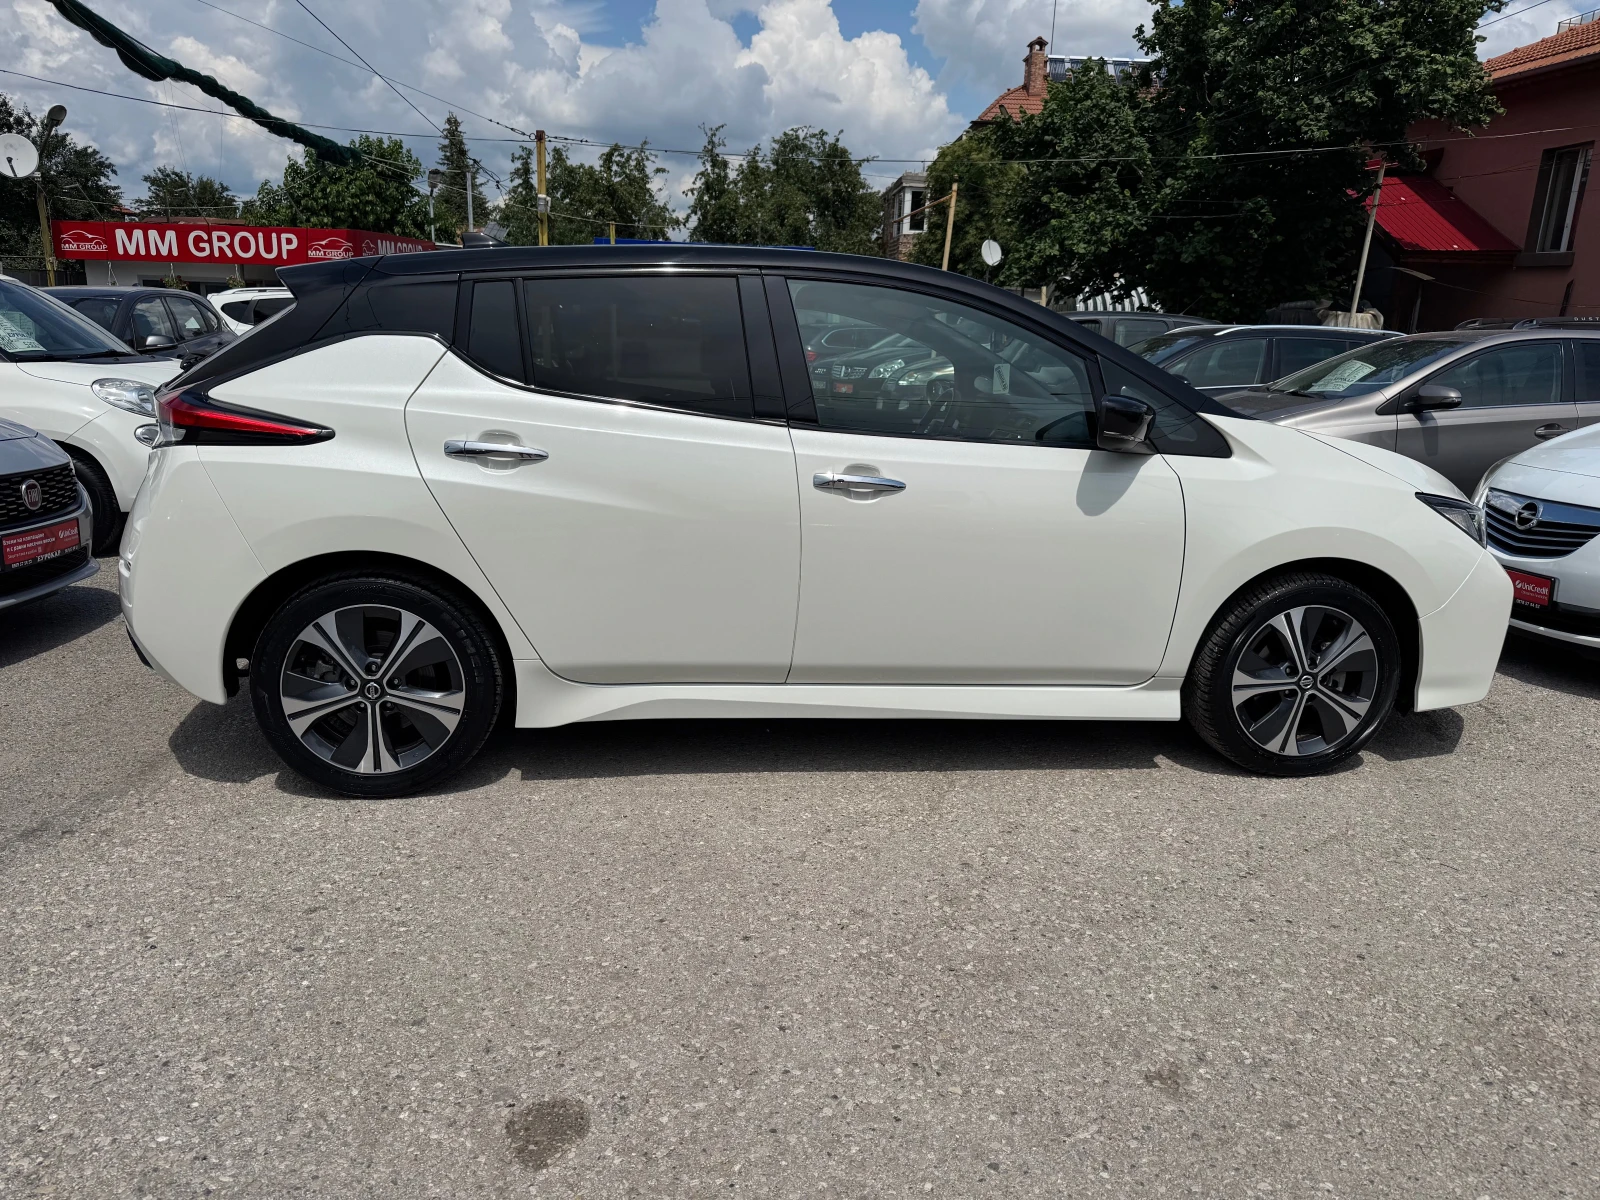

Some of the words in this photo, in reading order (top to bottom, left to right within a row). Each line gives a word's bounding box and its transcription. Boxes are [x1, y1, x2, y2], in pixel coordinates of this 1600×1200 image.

[115, 228, 179, 257] MM
[187, 230, 298, 260] GROUP
[377, 239, 395, 255] MM
[325, 251, 354, 259] GROUP
[1522, 582, 1548, 595] UniCredit
